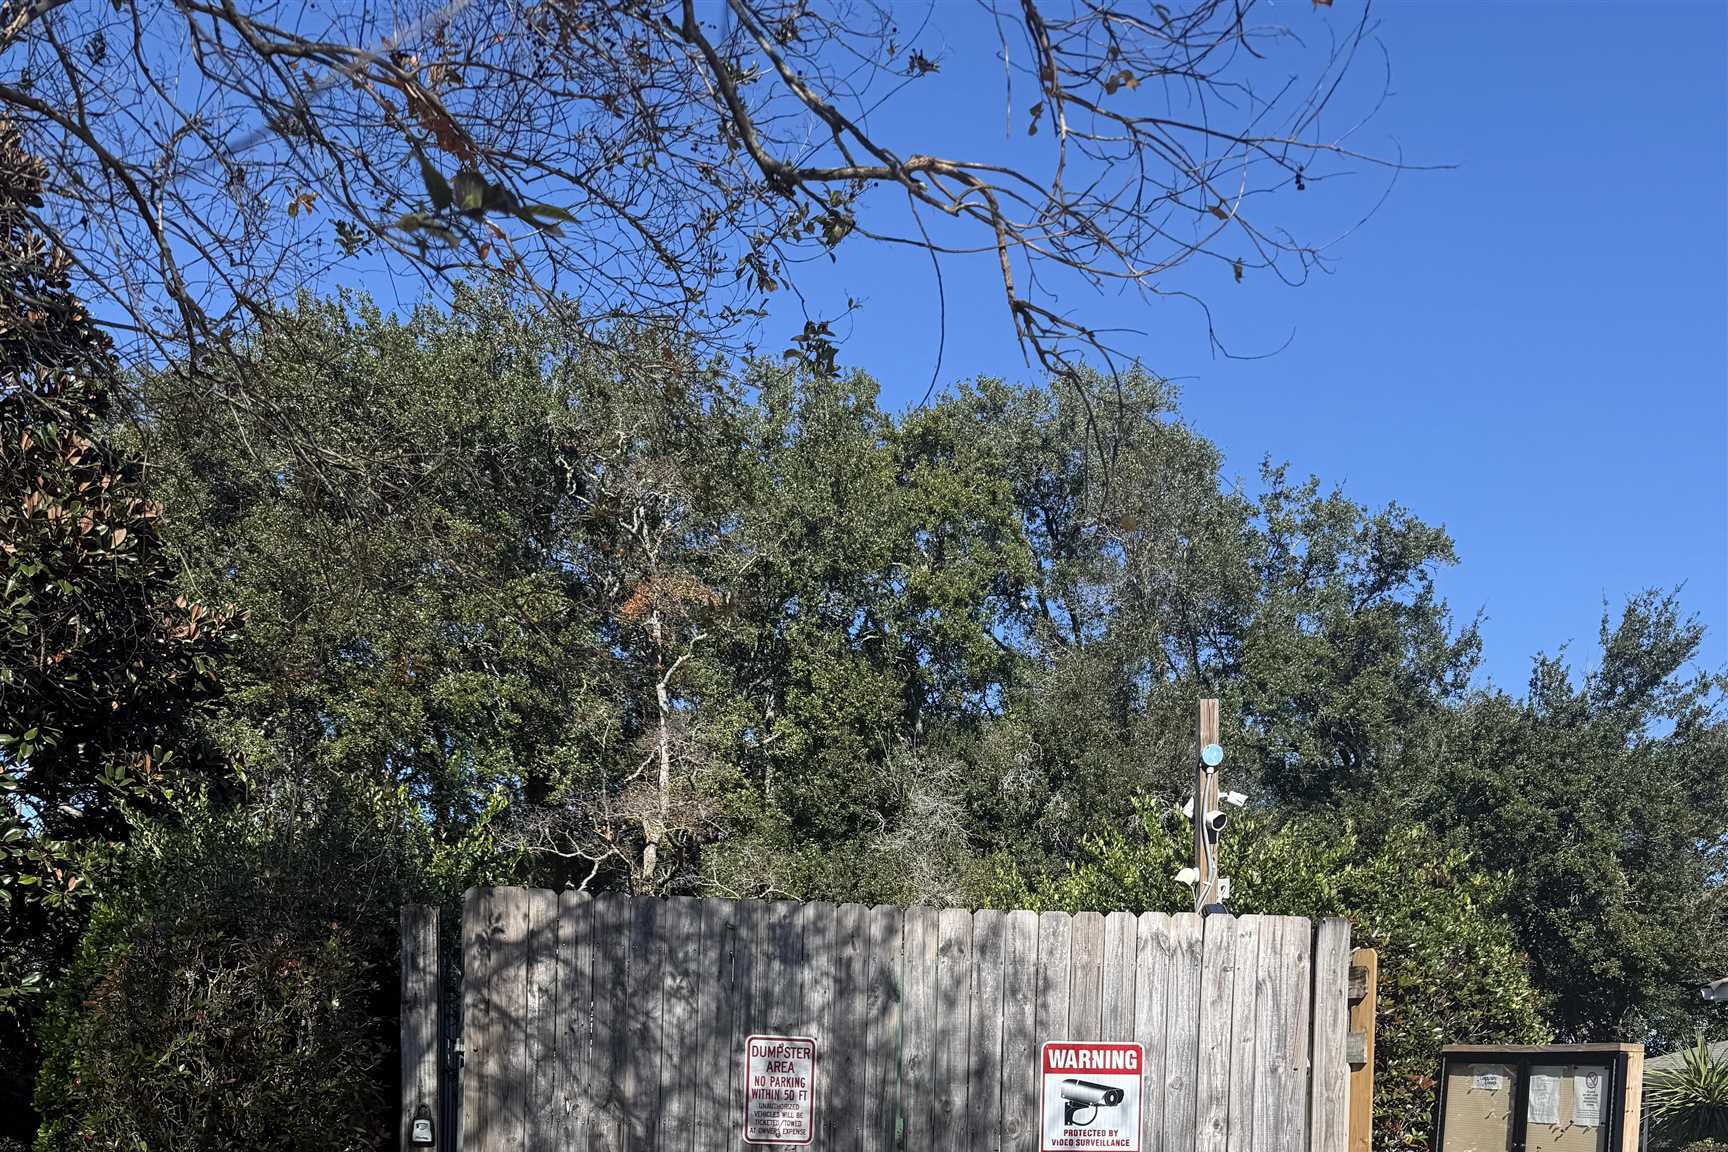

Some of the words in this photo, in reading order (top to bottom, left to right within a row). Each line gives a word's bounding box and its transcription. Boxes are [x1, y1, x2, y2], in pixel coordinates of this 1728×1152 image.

[751, 1045, 811, 1060] DUMPSTER
[1048, 1049, 1138, 1070] WARNING
[766, 1061, 795, 1073] AREA
[754, 1076, 766, 1087] NO
[770, 1076, 806, 1088] PARKING
[751, 1088, 780, 1101] WITHIN
[784, 1089, 795, 1101] 50
[799, 1090, 808, 1101] FT
[782, 1128, 806, 1136] EXPENSE
[1063, 1129, 1106, 1137] PROTECTED
[1108, 1129, 1119, 1137] BY
[1051, 1138, 1075, 1146] VIDEO
[1075, 1138, 1130, 1147] SURVEILLANCE
